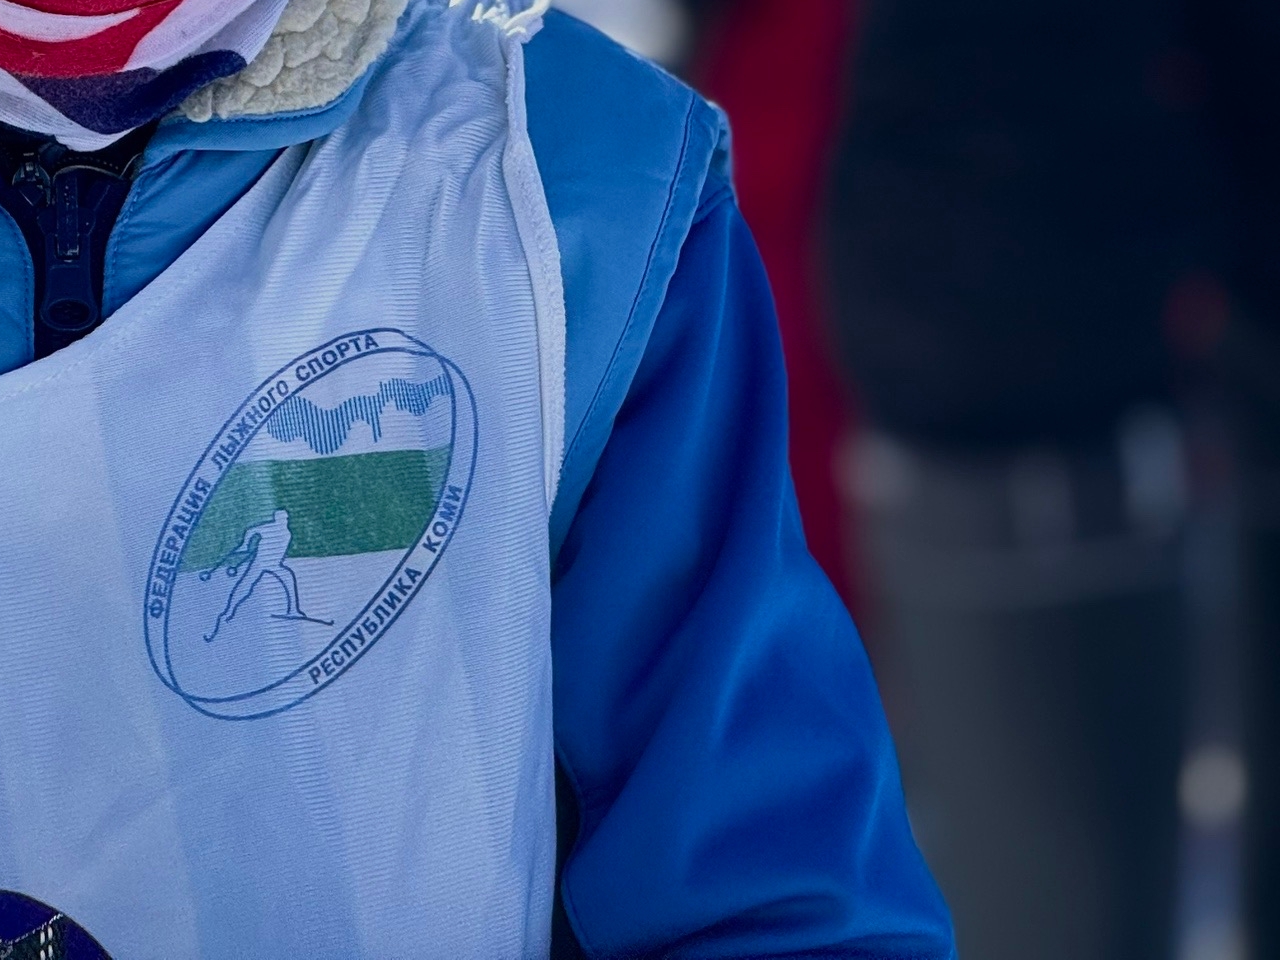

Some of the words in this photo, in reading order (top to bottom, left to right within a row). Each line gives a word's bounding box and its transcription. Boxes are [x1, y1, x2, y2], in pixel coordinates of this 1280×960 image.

[150, 475, 212, 619] ФЕДЕРАЦИЯ
[210, 379, 291, 472] ЛЫЖНОГО
[294, 332, 380, 383] СПОРТА
[307, 565, 424, 686] РЕСПУБЛИКА
[423, 484, 464, 554] КОМИ
